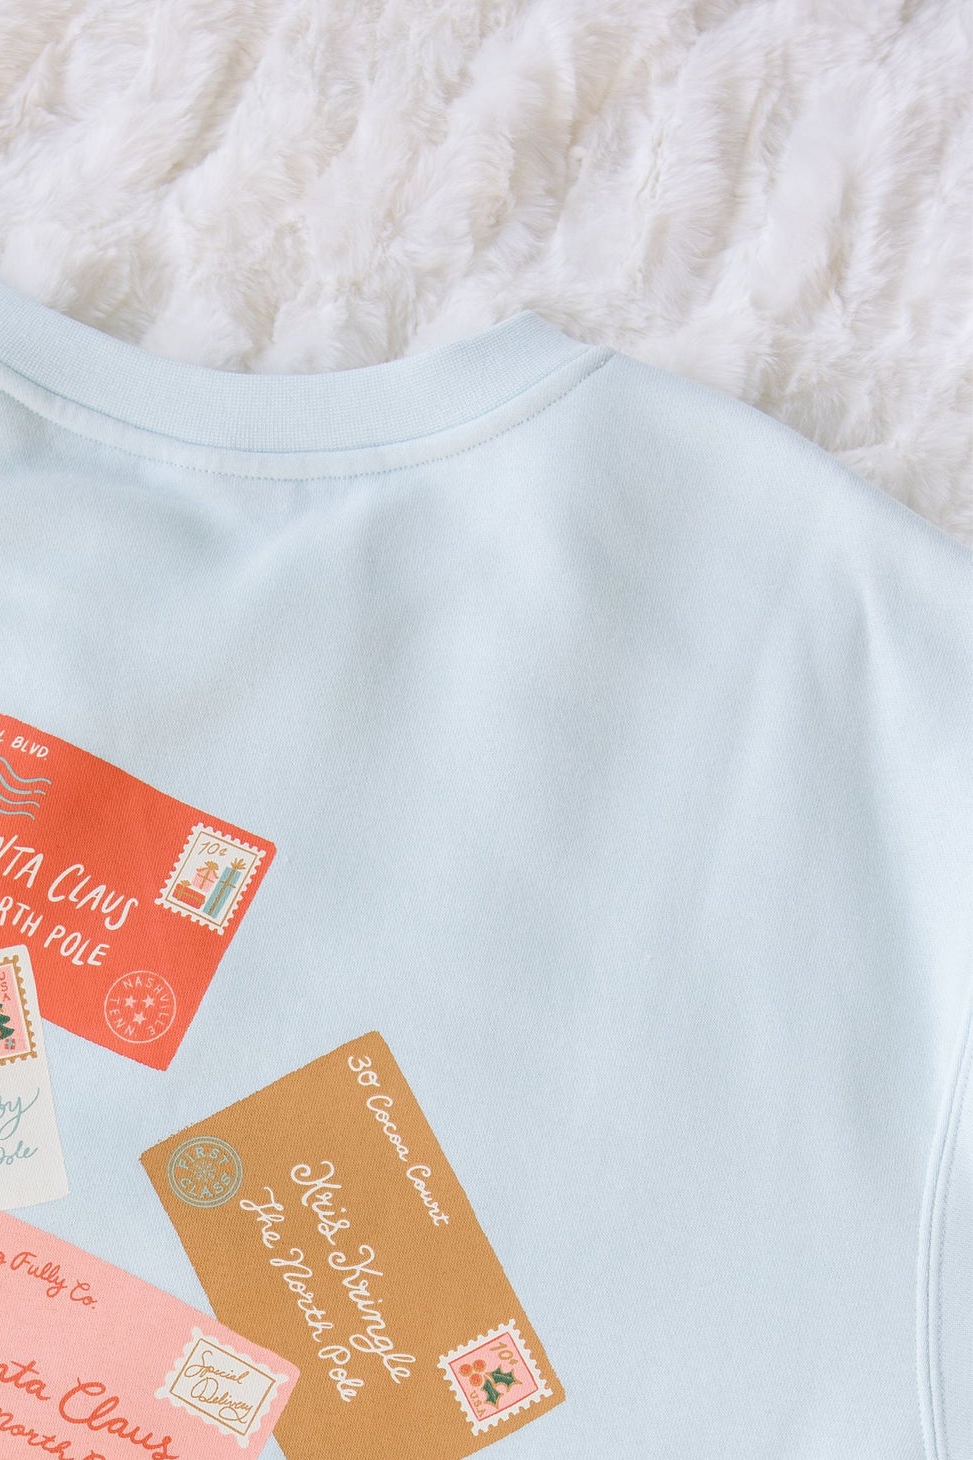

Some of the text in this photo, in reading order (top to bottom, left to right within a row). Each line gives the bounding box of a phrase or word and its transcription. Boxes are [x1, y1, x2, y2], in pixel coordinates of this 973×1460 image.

[11, 736, 49, 761] BLVD.
[48, 863, 138, 930] CLAUS
[44, 924, 110, 967] POLE
[123, 976, 169, 1035] NASHVILLE
[179, 1146, 229, 1170] FIRST
[348, 1056, 449, 1226] 30 Cocoa Court
[181, 1172, 231, 1198] CLASS
[10, 1252, 67, 1298] Fully
[70, 1280, 97, 1310] Co.
[240, 1187, 364, 1402] The North Pole
[290, 1160, 416, 1385] Kris Kringle
[184, 1350, 249, 1385] Special
[191, 1375, 254, 1423] Delivery
